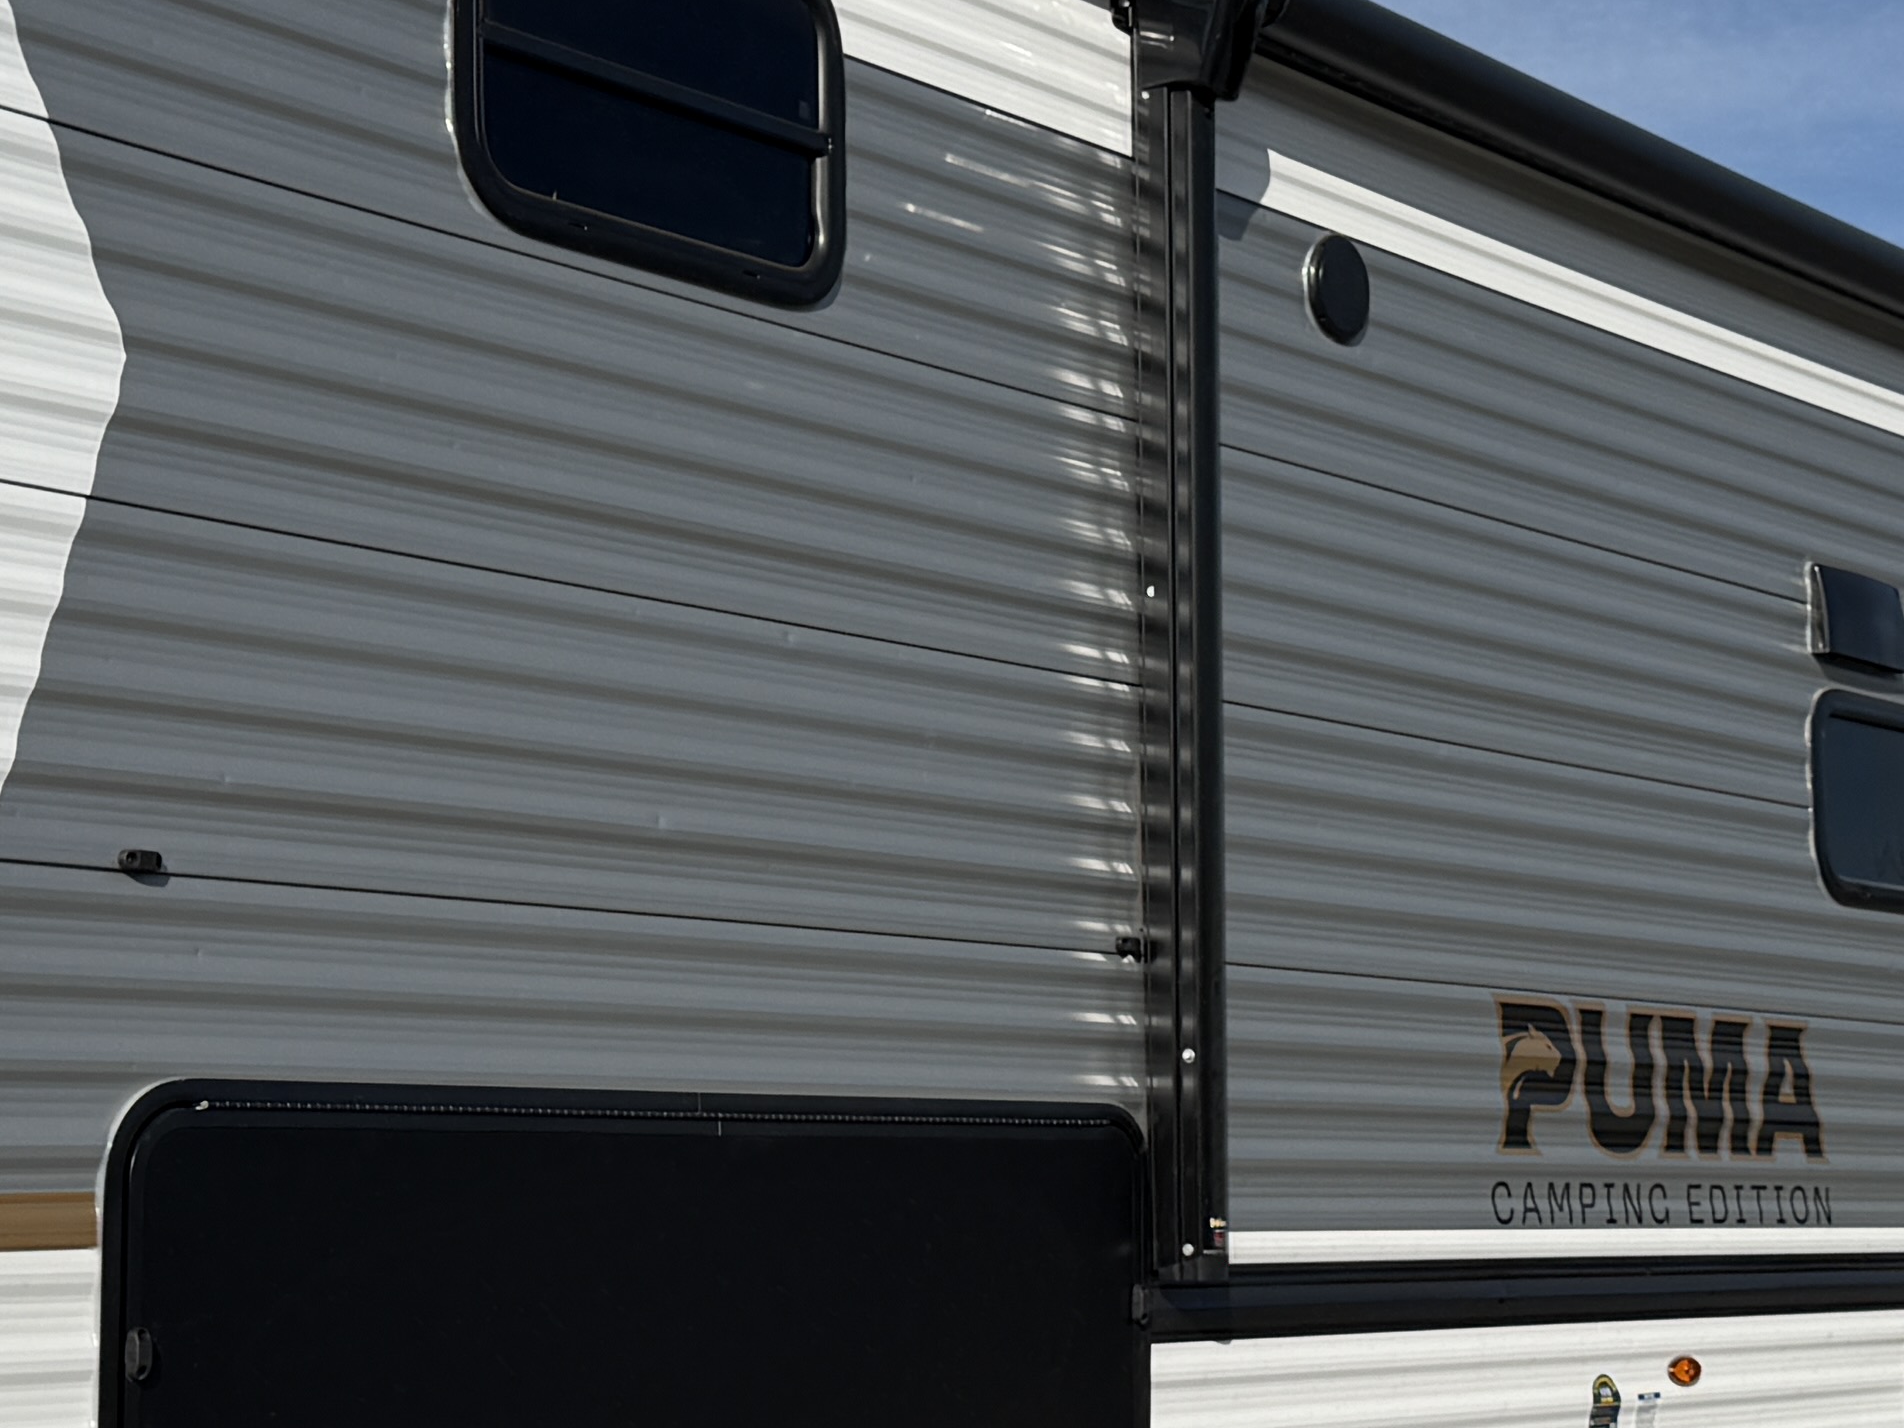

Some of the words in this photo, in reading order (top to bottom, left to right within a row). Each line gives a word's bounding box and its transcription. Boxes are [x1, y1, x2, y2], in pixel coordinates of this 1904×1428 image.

[1494, 993, 1830, 1164] PUMA
[1491, 1181, 1670, 1226] CAMPING
[1686, 1183, 1833, 1226] EDITION
